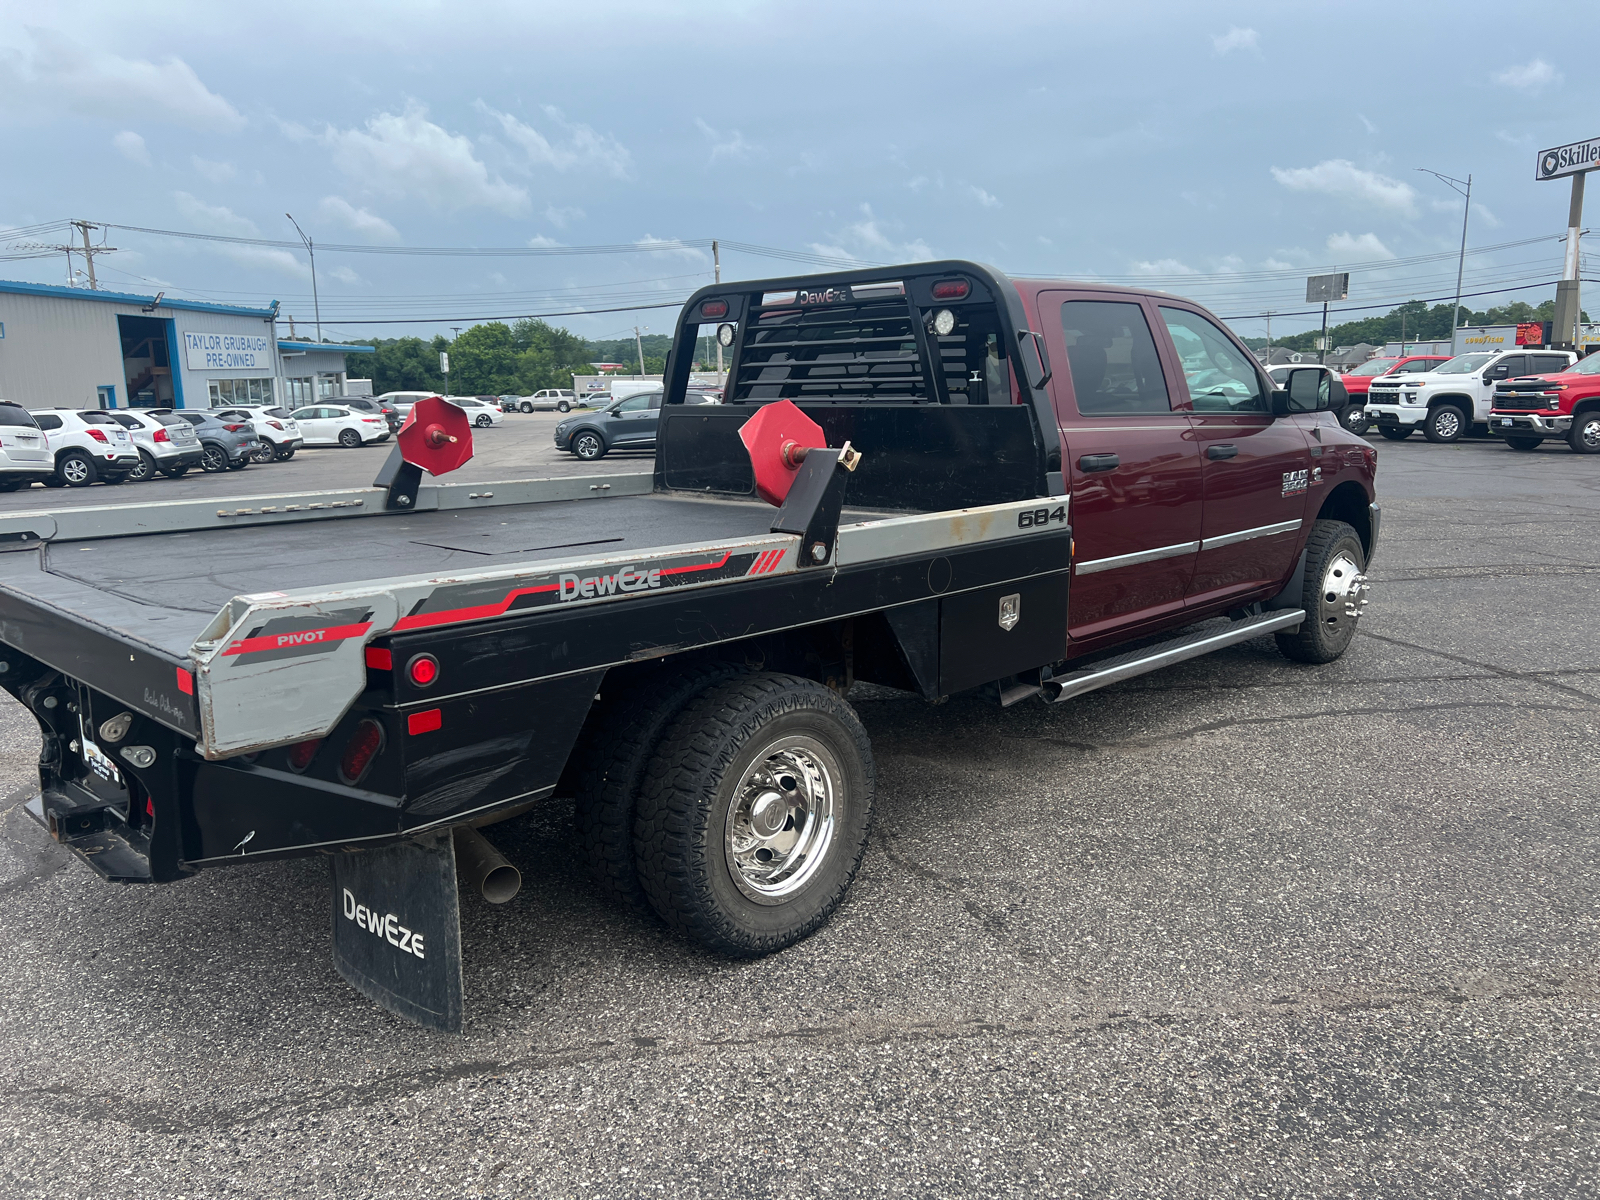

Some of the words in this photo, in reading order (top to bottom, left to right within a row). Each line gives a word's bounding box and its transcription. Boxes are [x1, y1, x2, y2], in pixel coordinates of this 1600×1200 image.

[186, 334, 222, 350] TAYLOR
[223, 336, 267, 351] GRUBAUGH
[206, 352, 256, 367] PRE-OWNED
[1282, 469, 1309, 482] RAM
[1018, 505, 1066, 529] 684
[277, 630, 325, 646] PIVOT
